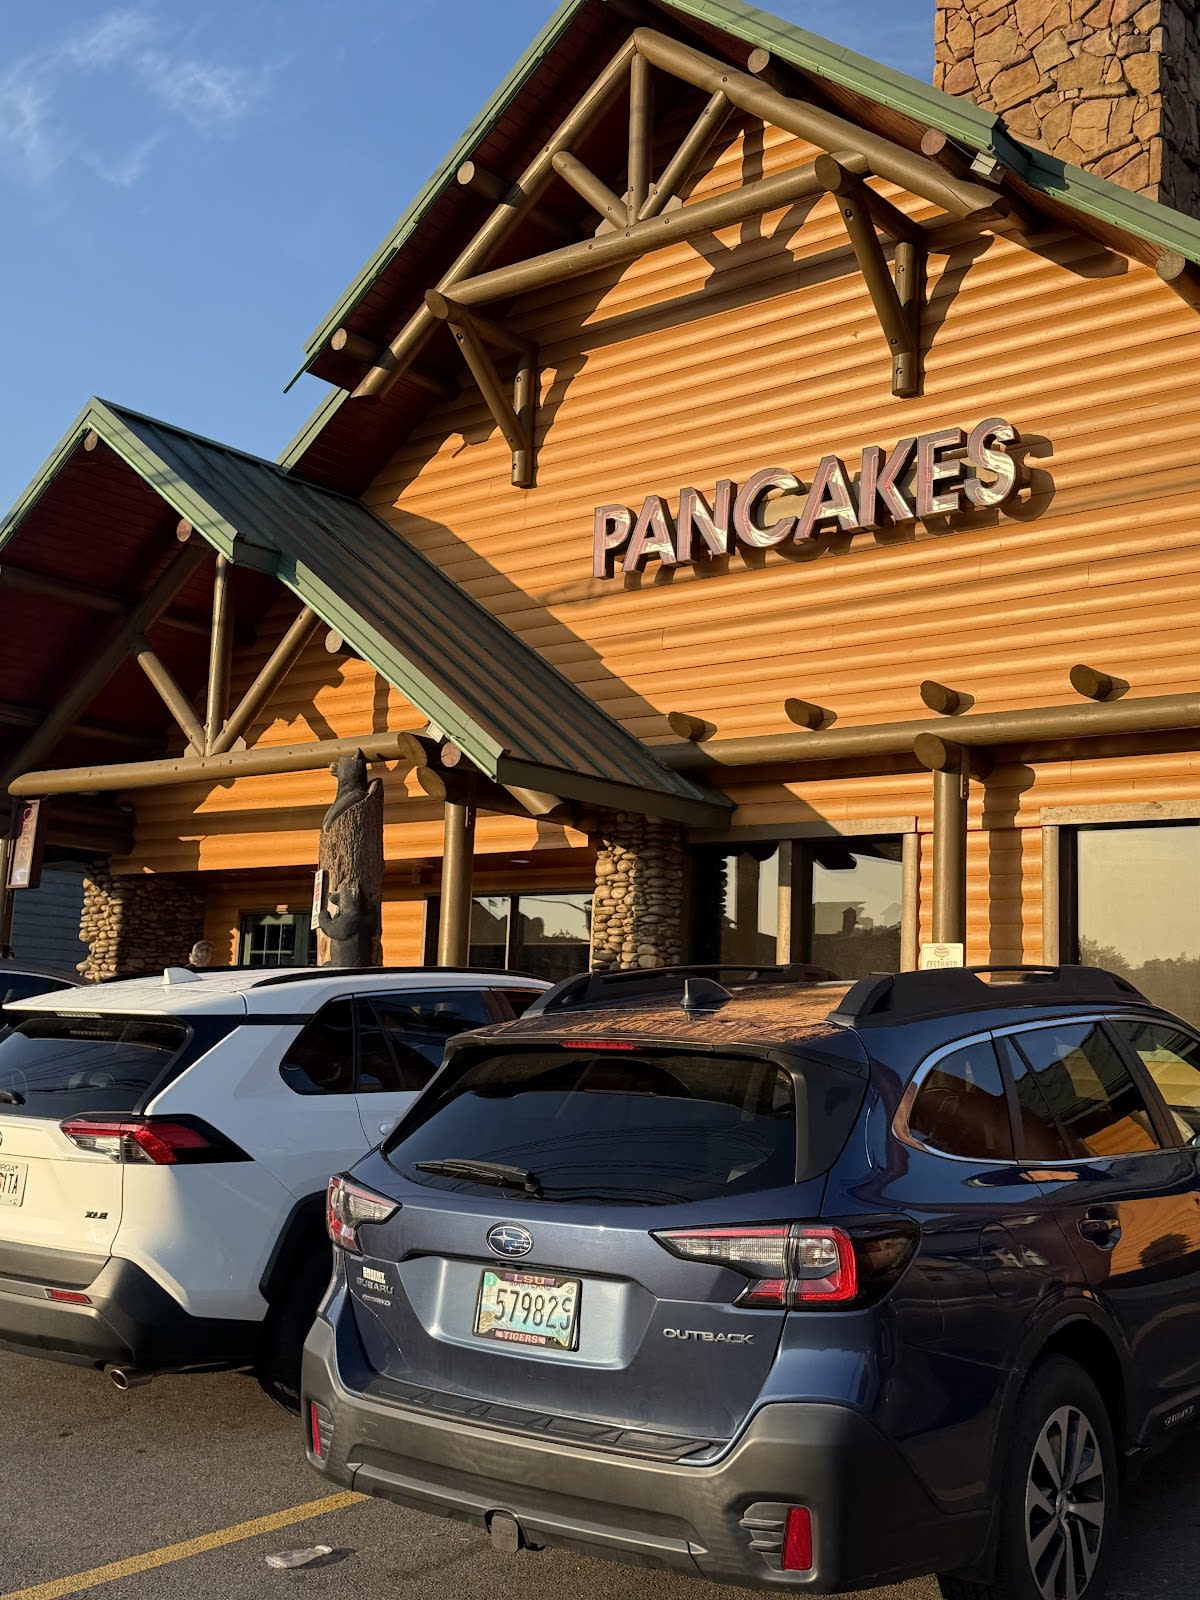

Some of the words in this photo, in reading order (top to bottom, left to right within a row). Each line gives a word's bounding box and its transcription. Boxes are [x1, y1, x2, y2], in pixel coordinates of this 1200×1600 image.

[593, 417, 1021, 579] PANCAKES
[84, 1211, 109, 1220] XLE
[356, 1277, 394, 1294] SUBARU
[512, 1274, 545, 1285] LSU
[502, 1331, 541, 1344] TIGERS
[662, 1327, 755, 1345] OUTBACK
